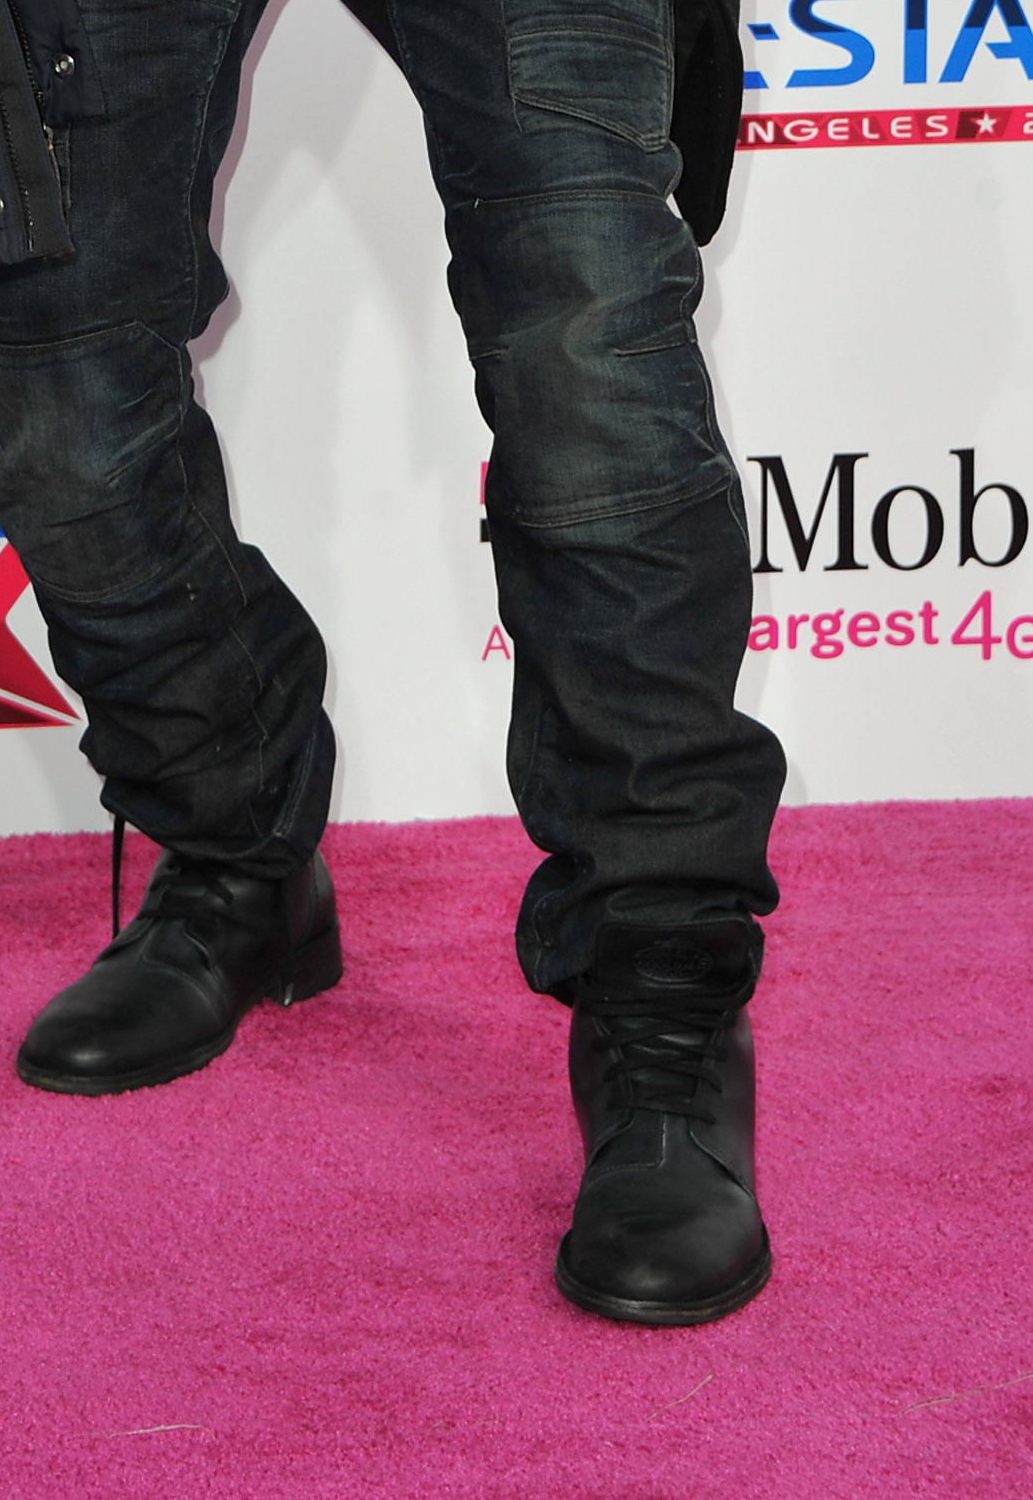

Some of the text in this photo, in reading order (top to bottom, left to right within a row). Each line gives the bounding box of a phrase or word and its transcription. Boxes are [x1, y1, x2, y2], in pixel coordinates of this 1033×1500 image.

[746, 112, 950, 143] NGELES
[746, 447, 1030, 573] Mob
[747, 601, 940, 659] argest
